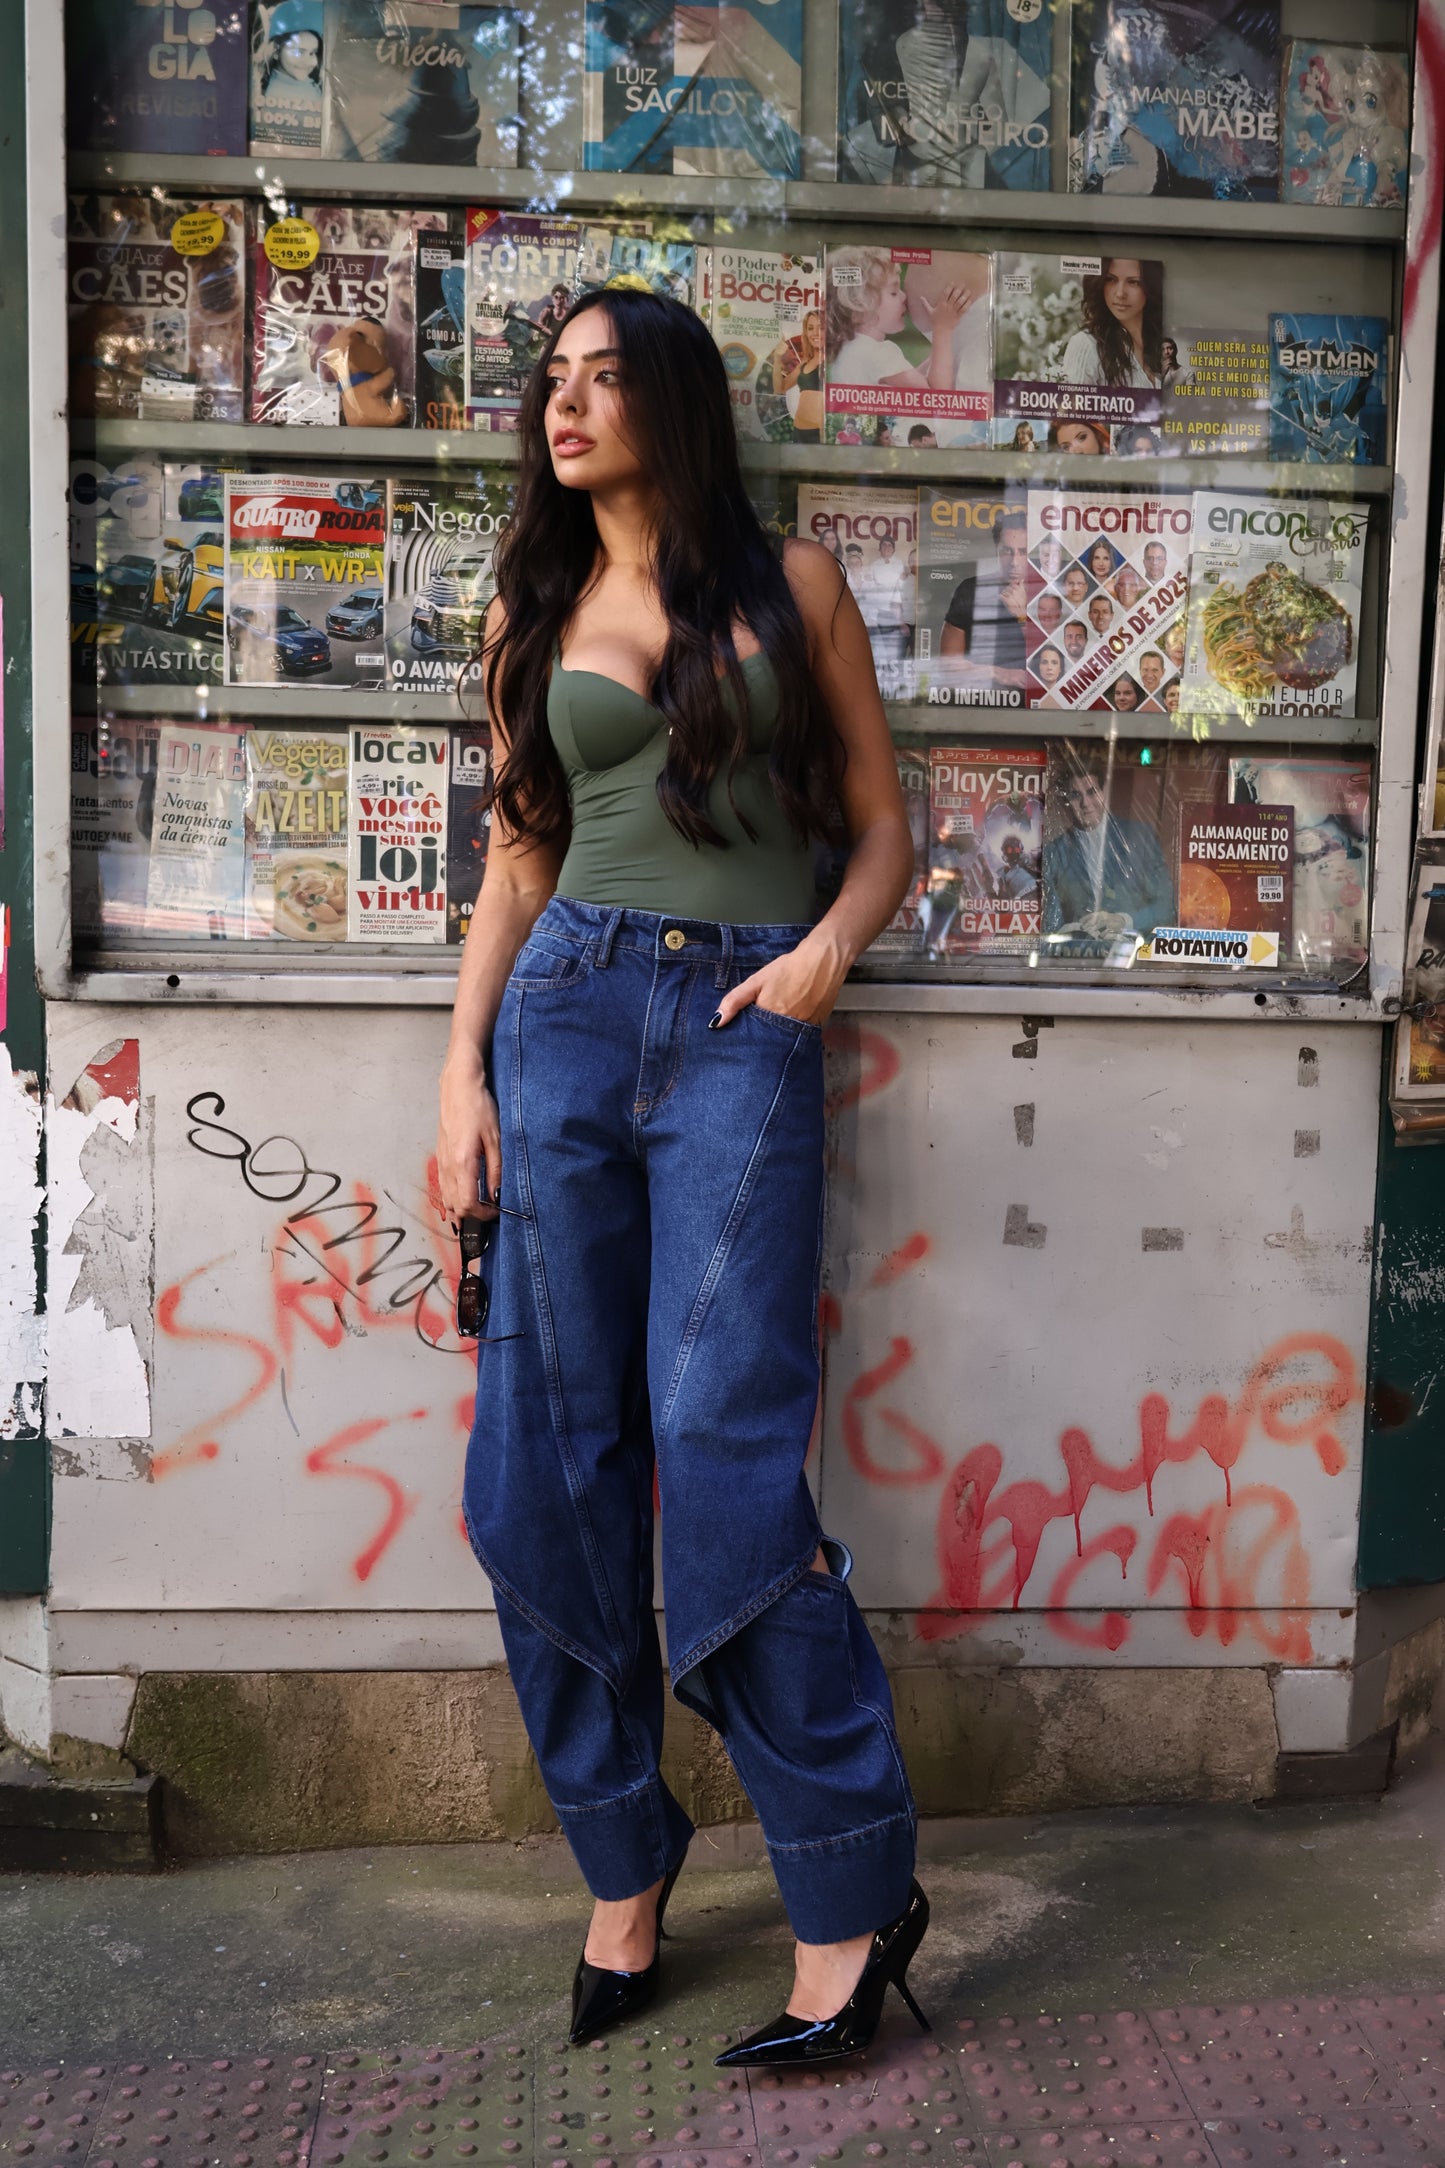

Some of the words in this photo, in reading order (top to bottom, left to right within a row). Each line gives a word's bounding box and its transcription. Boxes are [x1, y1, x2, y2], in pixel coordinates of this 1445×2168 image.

[148, 42, 217, 81] GIA
[616, 67, 658, 85] LUIZ
[1133, 86, 1220, 106] MANABU
[880, 114, 1049, 149] MONTEIRO
[1178, 108, 1277, 141] MABE
[513, 235, 539, 245] GUIA
[97, 247, 147, 266] GUIA
[281, 249, 310, 261] 19,99
[721, 255, 733, 268] O
[737, 256, 779, 272] Poder
[348, 263, 365, 276] DE
[737, 269, 775, 284] Dieta
[72, 263, 187, 305] CÃES
[278, 274, 388, 316] CÃES
[731, 316, 780, 327] EMAGRECER
[426, 328, 449, 342] COMO
[450, 330, 456, 342] A
[474, 347, 514, 357] TESTAMOS
[474, 355, 486, 363] OS
[487, 356, 511, 364] MITOS
[1279, 349, 1378, 370] BATMAN
[1190, 356, 1226, 368] METADE
[1227, 357, 1239, 368] DO
[1241, 358, 1257, 369] FIM
[1197, 371, 1217, 383] DIAS
[1219, 372, 1225, 383] E
[1227, 373, 1249, 384] MEIO
[1251, 373, 1262, 384] DA
[1288, 367, 1316, 376] JOGOS
[1324, 369, 1370, 378] ATIVIDADES
[1058, 385, 1090, 393] FOTOGRAFIA
[1174, 385, 1193, 396] QUE
[1211, 386, 1222, 397] DE
[1224, 387, 1239, 398] VIR
[1241, 387, 1269, 399] SOBRE
[829, 388, 903, 406] FOTOGRAFIA
[905, 392, 920, 407] DE
[923, 393, 989, 411] GESTANTES
[1020, 391, 1059, 409] BOOK
[1061, 395, 1073, 410] &
[1075, 394, 1135, 414] RETRATO
[1187, 421, 1262, 437] APOCALIPSE
[1191, 439, 1206, 451] VS
[1210, 440, 1216, 451] 1
[1221, 440, 1230, 452] A
[1234, 440, 1249, 453] 18
[273, 478, 291, 488] APÓS
[291, 480, 320, 489] 100.000
[233, 497, 320, 538] QUATRO
[393, 504, 415, 514] veja
[320, 510, 385, 531] RODA
[1040, 502, 1191, 535] encontro
[256, 546, 286, 554] NISSAN
[343, 551, 371, 560] HONDA
[243, 555, 300, 579] KAIT
[1059, 626, 1134, 704] MINEIROS
[1127, 606, 1156, 636] DE
[1148, 570, 1188, 612] 2025
[392, 659, 406, 678] O
[409, 661, 484, 686] AVANÇO
[928, 687, 950, 705] AO
[954, 688, 1021, 707] INFINITO
[1265, 685, 1343, 705] MELHOR
[975, 753, 1000, 762] PS4
[257, 779, 279, 790] DOSSIÊ
[280, 781, 289, 790] DO
[163, 792, 208, 812] Novas
[255, 789, 344, 833] AZEIT
[359, 793, 443, 819] você
[161, 812, 233, 832] conquistas
[358, 819, 443, 834] mesmo
[160, 826, 177, 842] da
[180, 828, 228, 847] ciência
[379, 835, 417, 847] sua
[1190, 825, 1268, 842] ALMANAQUE
[1271, 827, 1289, 842] DO
[1188, 842, 1289, 862] PENSAMENTO
[964, 896, 1039, 914] GUARDIÕES
[960, 912, 1041, 934] GALAX
[1156, 929, 1248, 942] ESTACIONAMENTO
[1155, 938, 1248, 959] ROTATIVO
[1209, 956, 1228, 964] FAIXA
[1229, 957, 1245, 965] AZUL
